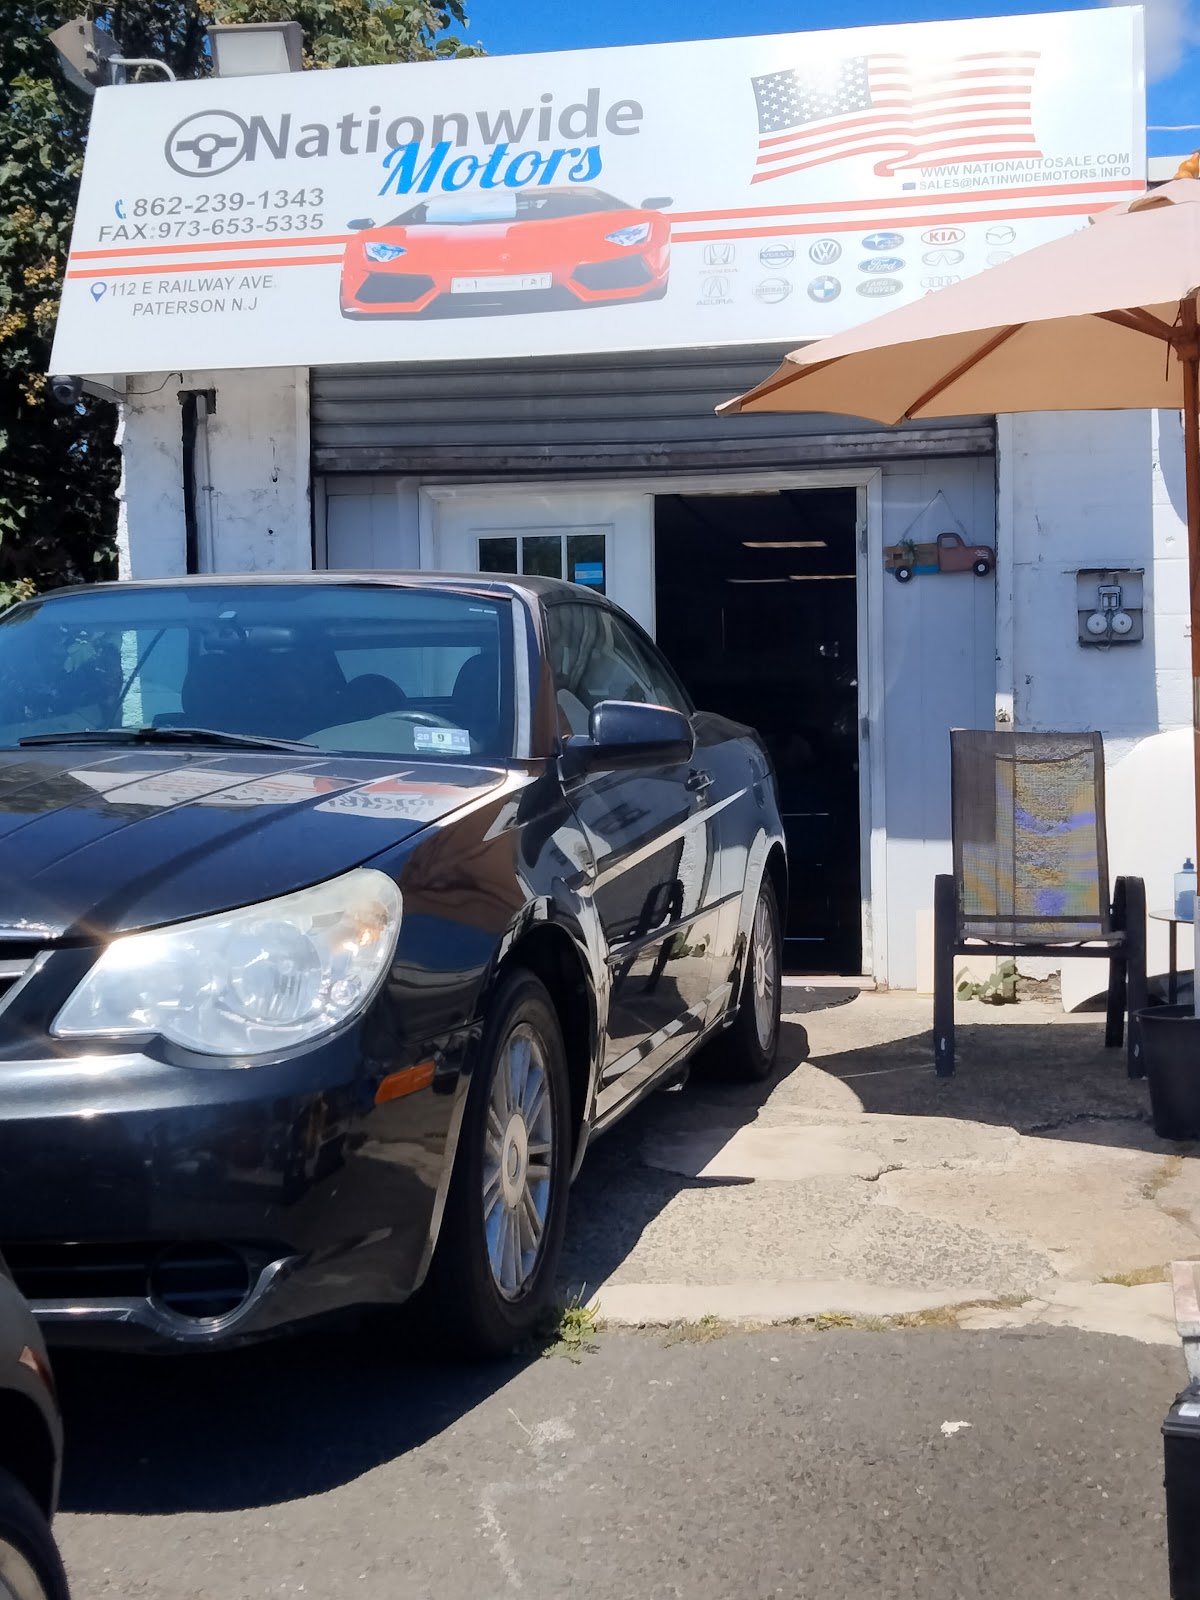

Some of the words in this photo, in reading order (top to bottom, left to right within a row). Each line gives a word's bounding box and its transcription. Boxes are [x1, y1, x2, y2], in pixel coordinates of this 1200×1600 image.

[245, 88, 643, 161] Nationwide
[377, 141, 602, 196] Motors
[133, 188, 324, 217] 862-239-1343
[929, 231, 958, 241] KIA
[761, 250, 794, 259] VOLVO
[868, 258, 896, 271] Ford
[110, 281, 136, 296] 112
[142, 280, 152, 294] E
[158, 276, 234, 294] RAILWAY
[867, 285, 896, 294] ROVER
[132, 298, 225, 316] PATERSON
[696, 298, 734, 306] ACURA
[437, 733, 445, 743] 9
